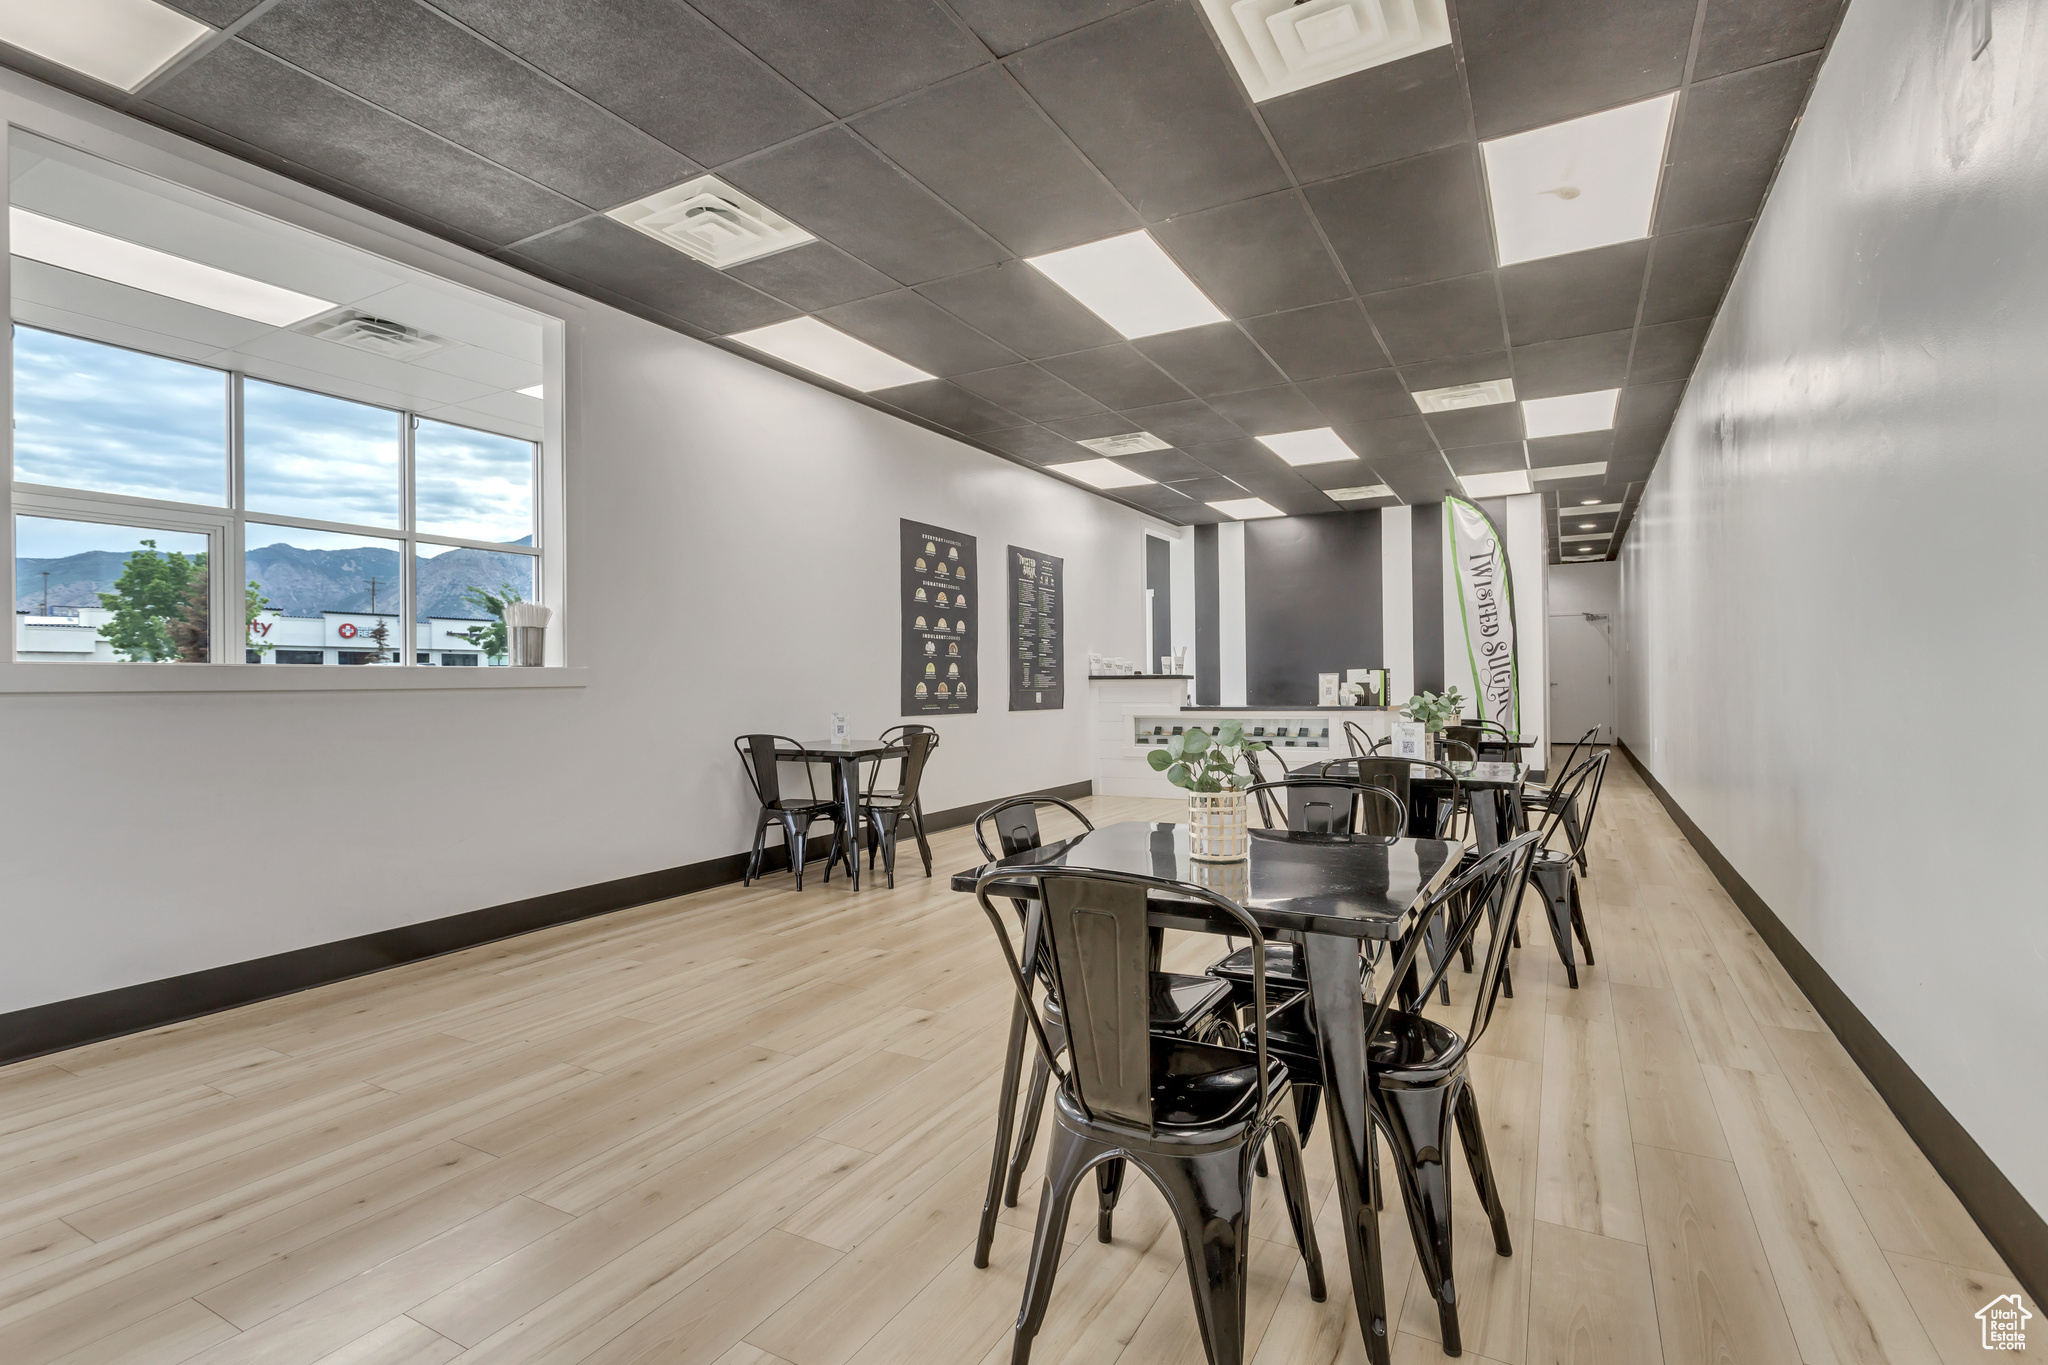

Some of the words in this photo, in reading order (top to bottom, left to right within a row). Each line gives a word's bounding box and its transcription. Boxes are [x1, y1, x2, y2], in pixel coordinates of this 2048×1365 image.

[922, 534, 943, 542] EVERYDAY
[922, 580, 945, 588] SIGNATURE
[1469, 538, 1499, 637] TWISTED
